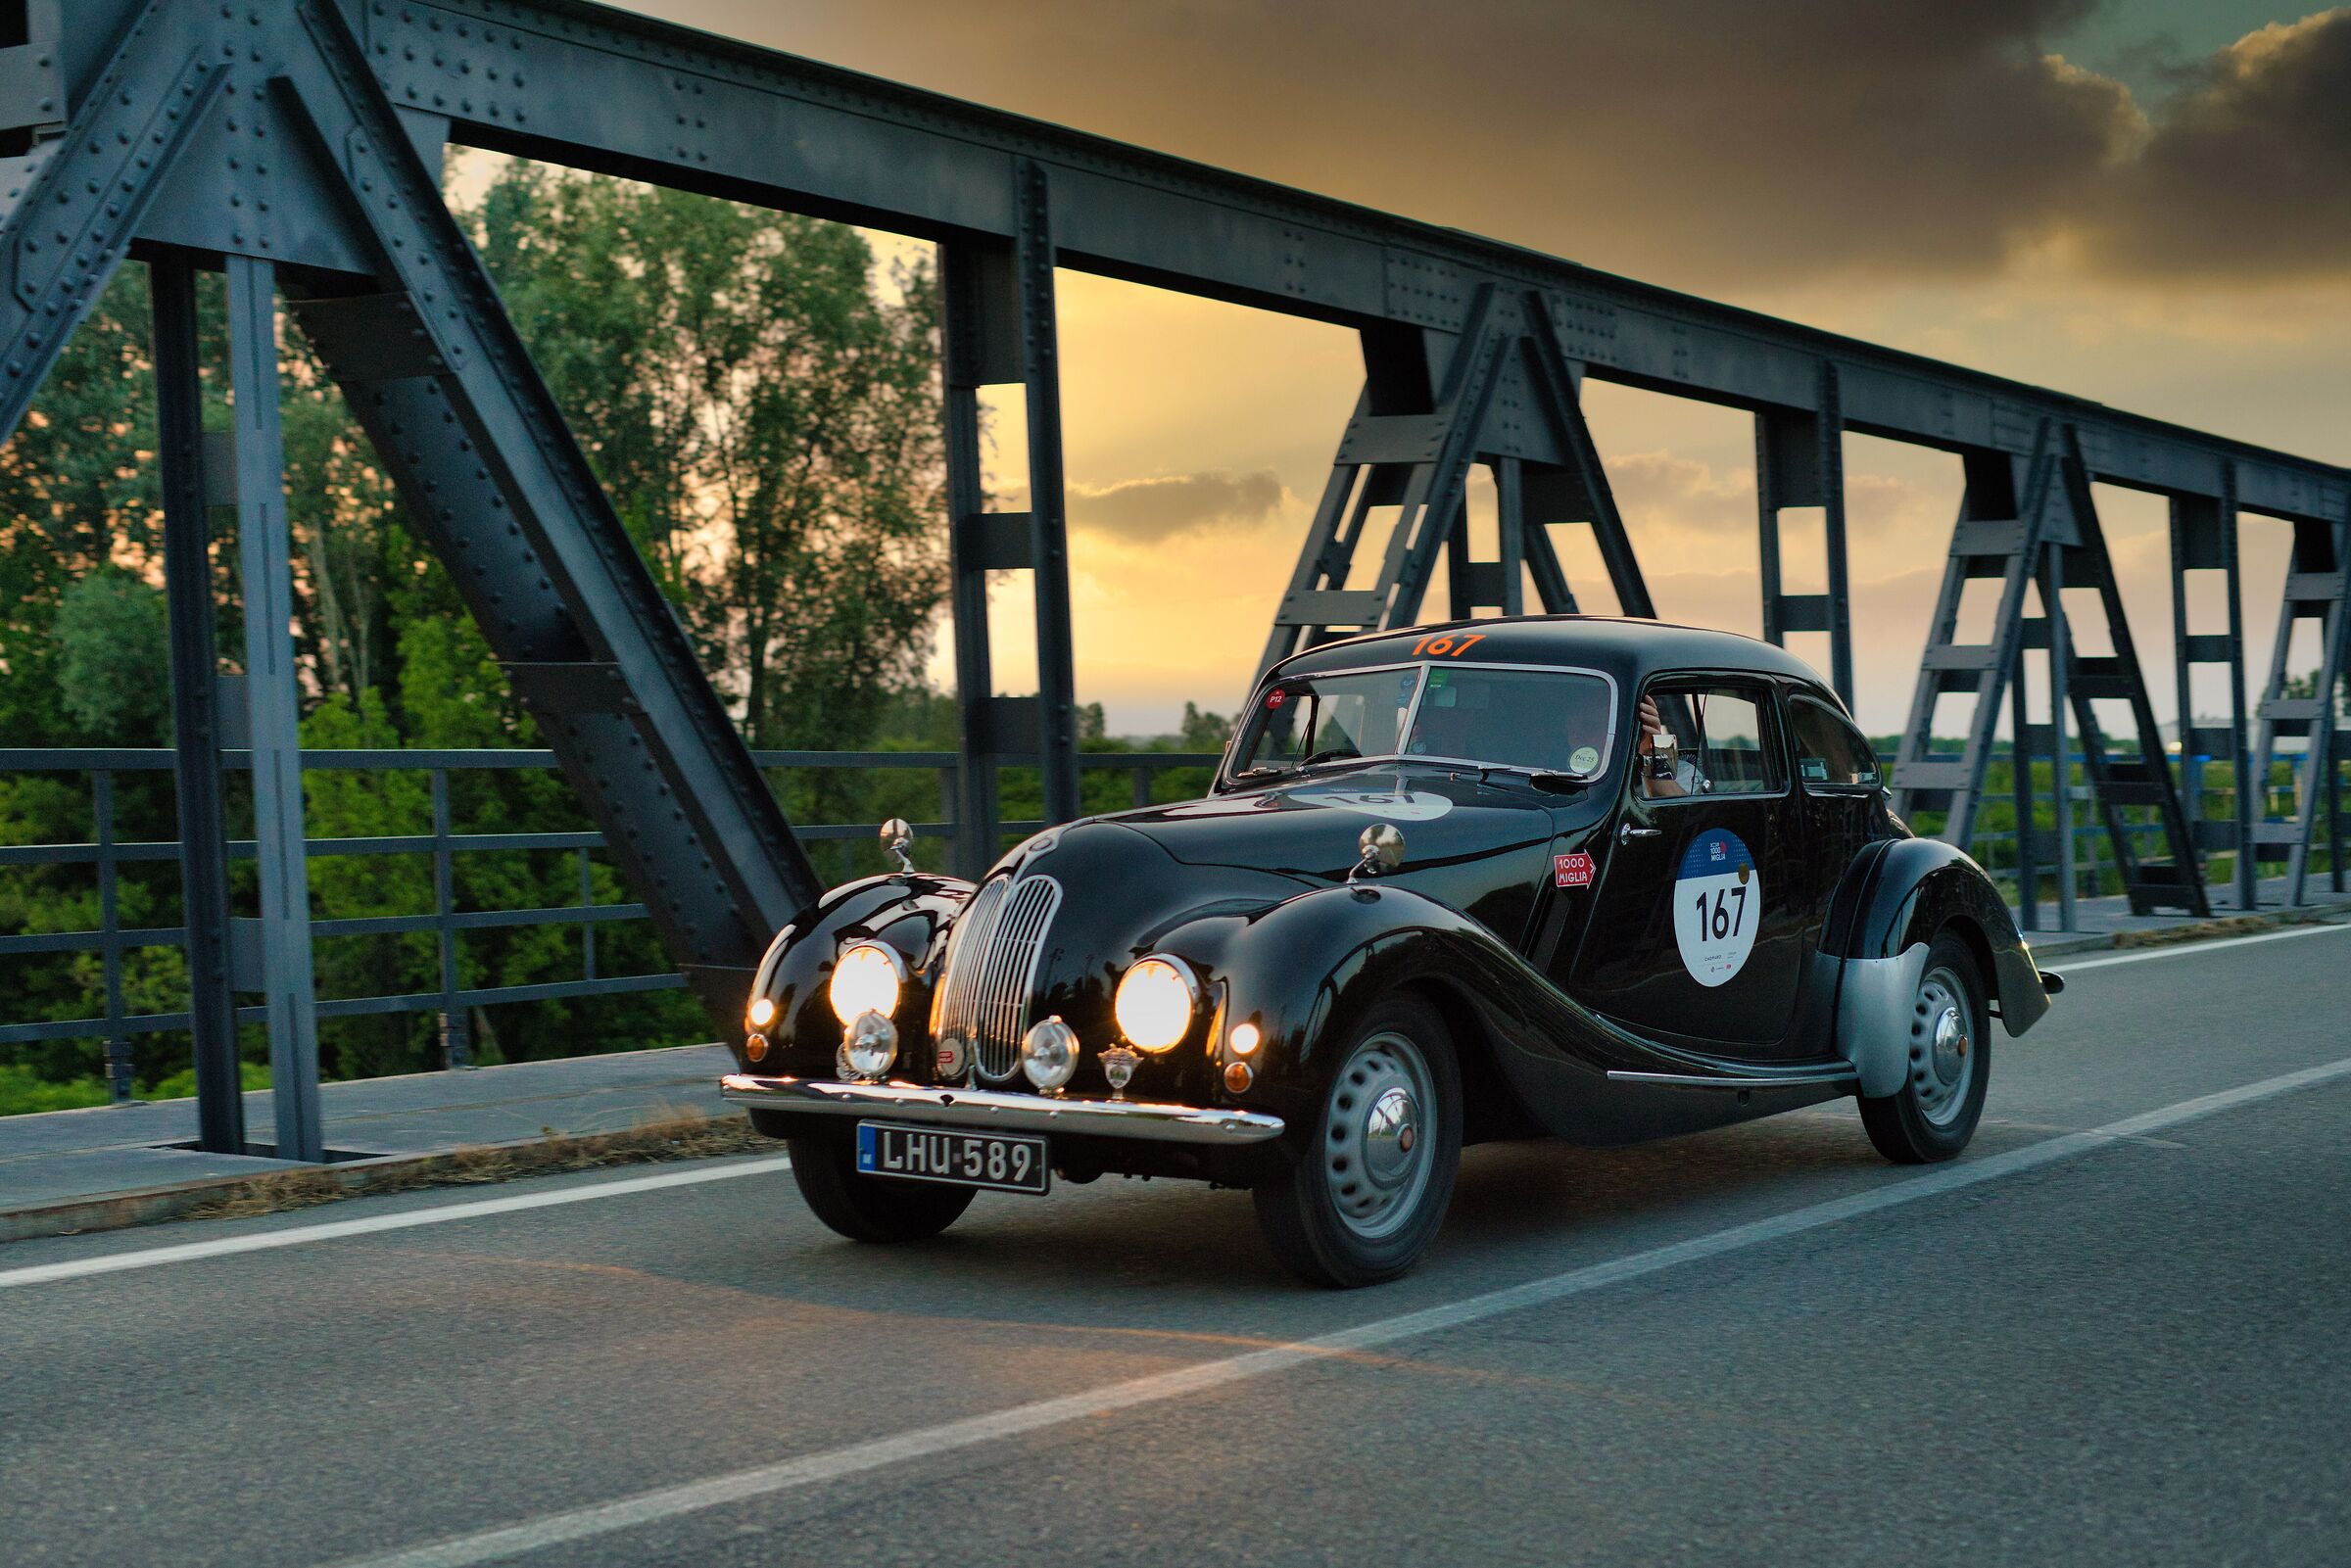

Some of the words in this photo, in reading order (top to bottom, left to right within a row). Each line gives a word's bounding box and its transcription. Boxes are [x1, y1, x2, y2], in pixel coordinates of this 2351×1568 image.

[1412, 634, 1487, 657] 167
[1559, 857, 1585, 869] 1000
[1559, 871, 1588, 883] MIGLIA
[1696, 886, 1747, 942] 167
[884, 1131, 950, 1175] LHU
[963, 1139, 1032, 1182] 589
